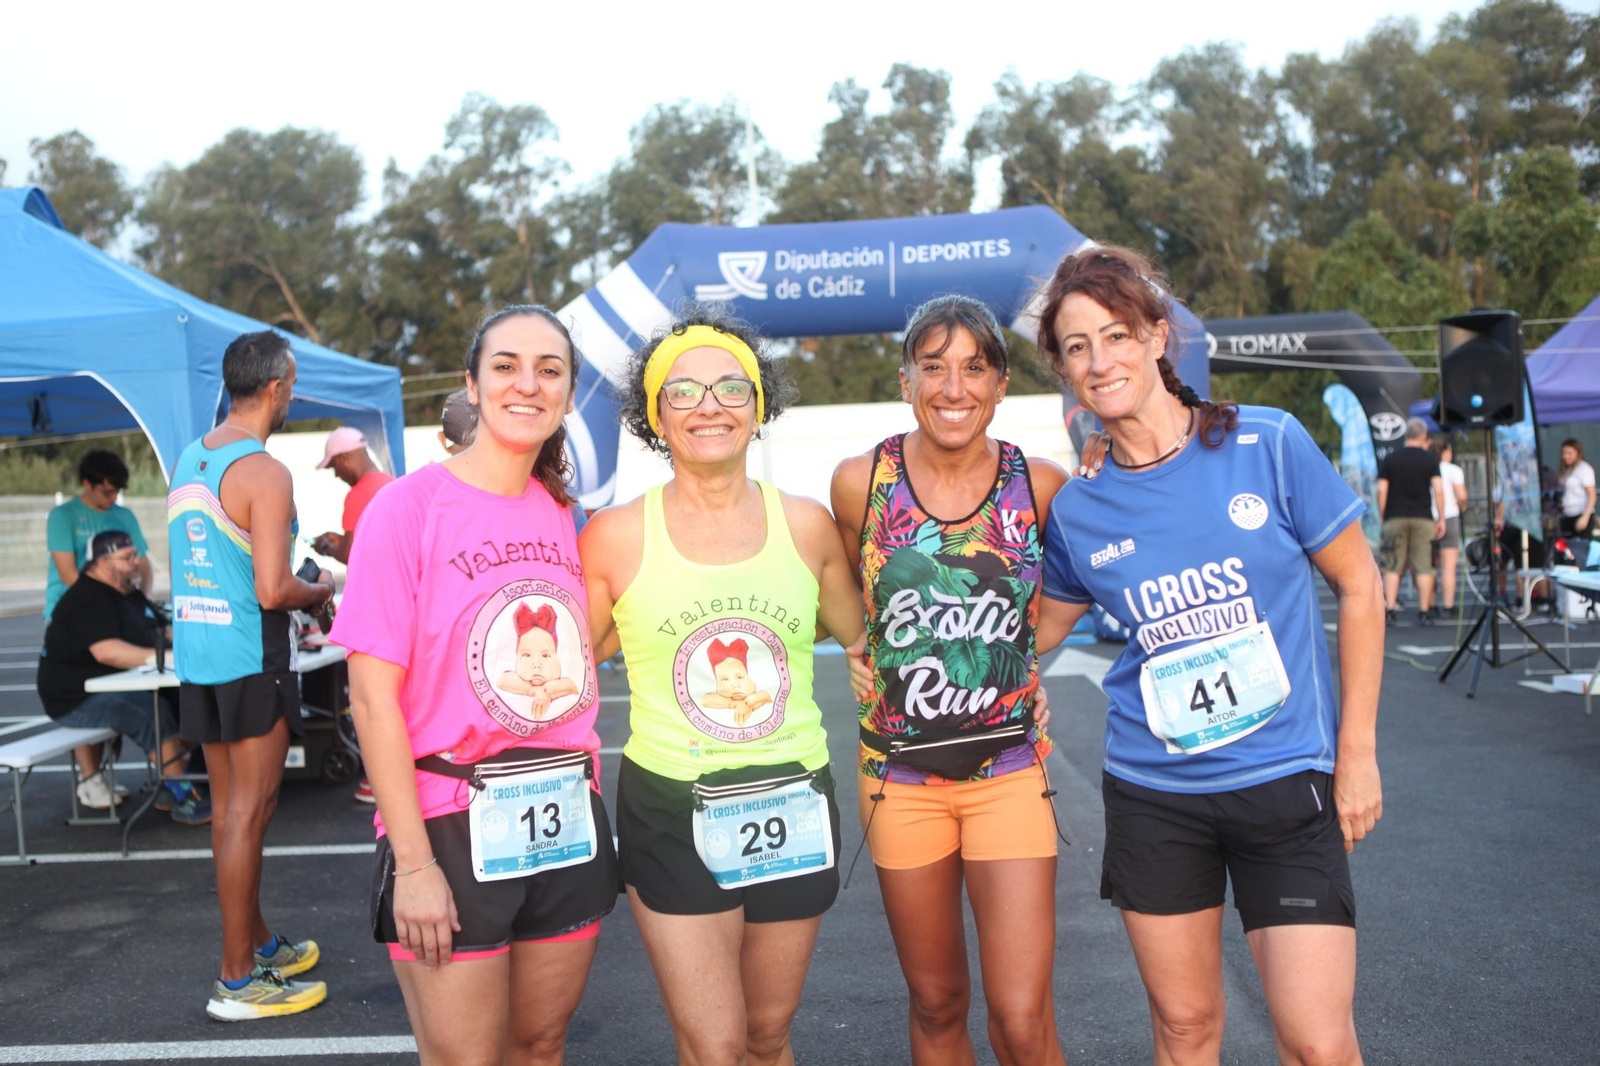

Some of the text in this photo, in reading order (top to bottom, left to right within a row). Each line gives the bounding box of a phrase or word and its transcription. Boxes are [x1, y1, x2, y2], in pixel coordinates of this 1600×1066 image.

[774, 246, 884, 274] Diputación
[902, 238, 1011, 264] DEPORTES
[775, 274, 865, 300] de Cádiz
[1228, 332, 1308, 355] TOMAX
[449, 536, 584, 586] Valentina
[502, 581, 570, 605] Asociación
[1139, 557, 1248, 620] CROSS
[658, 594, 801, 637] Valentina
[880, 585, 1022, 648] Exotic
[1142, 602, 1248, 650] INCLUSIVO
[678, 619, 759, 660] Investigación
[765, 634, 782, 657] Cura
[898, 656, 999, 720] Run
[1155, 662, 1182, 680] CROSS
[473, 678, 489, 699] El
[486, 698, 529, 735] camino
[1190, 671, 1239, 715] 41
[681, 699, 696, 717] El
[692, 715, 735, 741] camino
[738, 730, 753, 741] de
[754, 689, 789, 737] Valentina
[1207, 710, 1237, 725] AITOR
[493, 785, 520, 800] CROSS
[523, 779, 562, 796] INCLUSIVO
[708, 796, 786, 820] I CROSS INCLUSIVO
[521, 802, 561, 842] 13
[740, 816, 787, 857] 29
[525, 840, 558, 853] SANDRA
[750, 851, 782, 864] ISABEL
